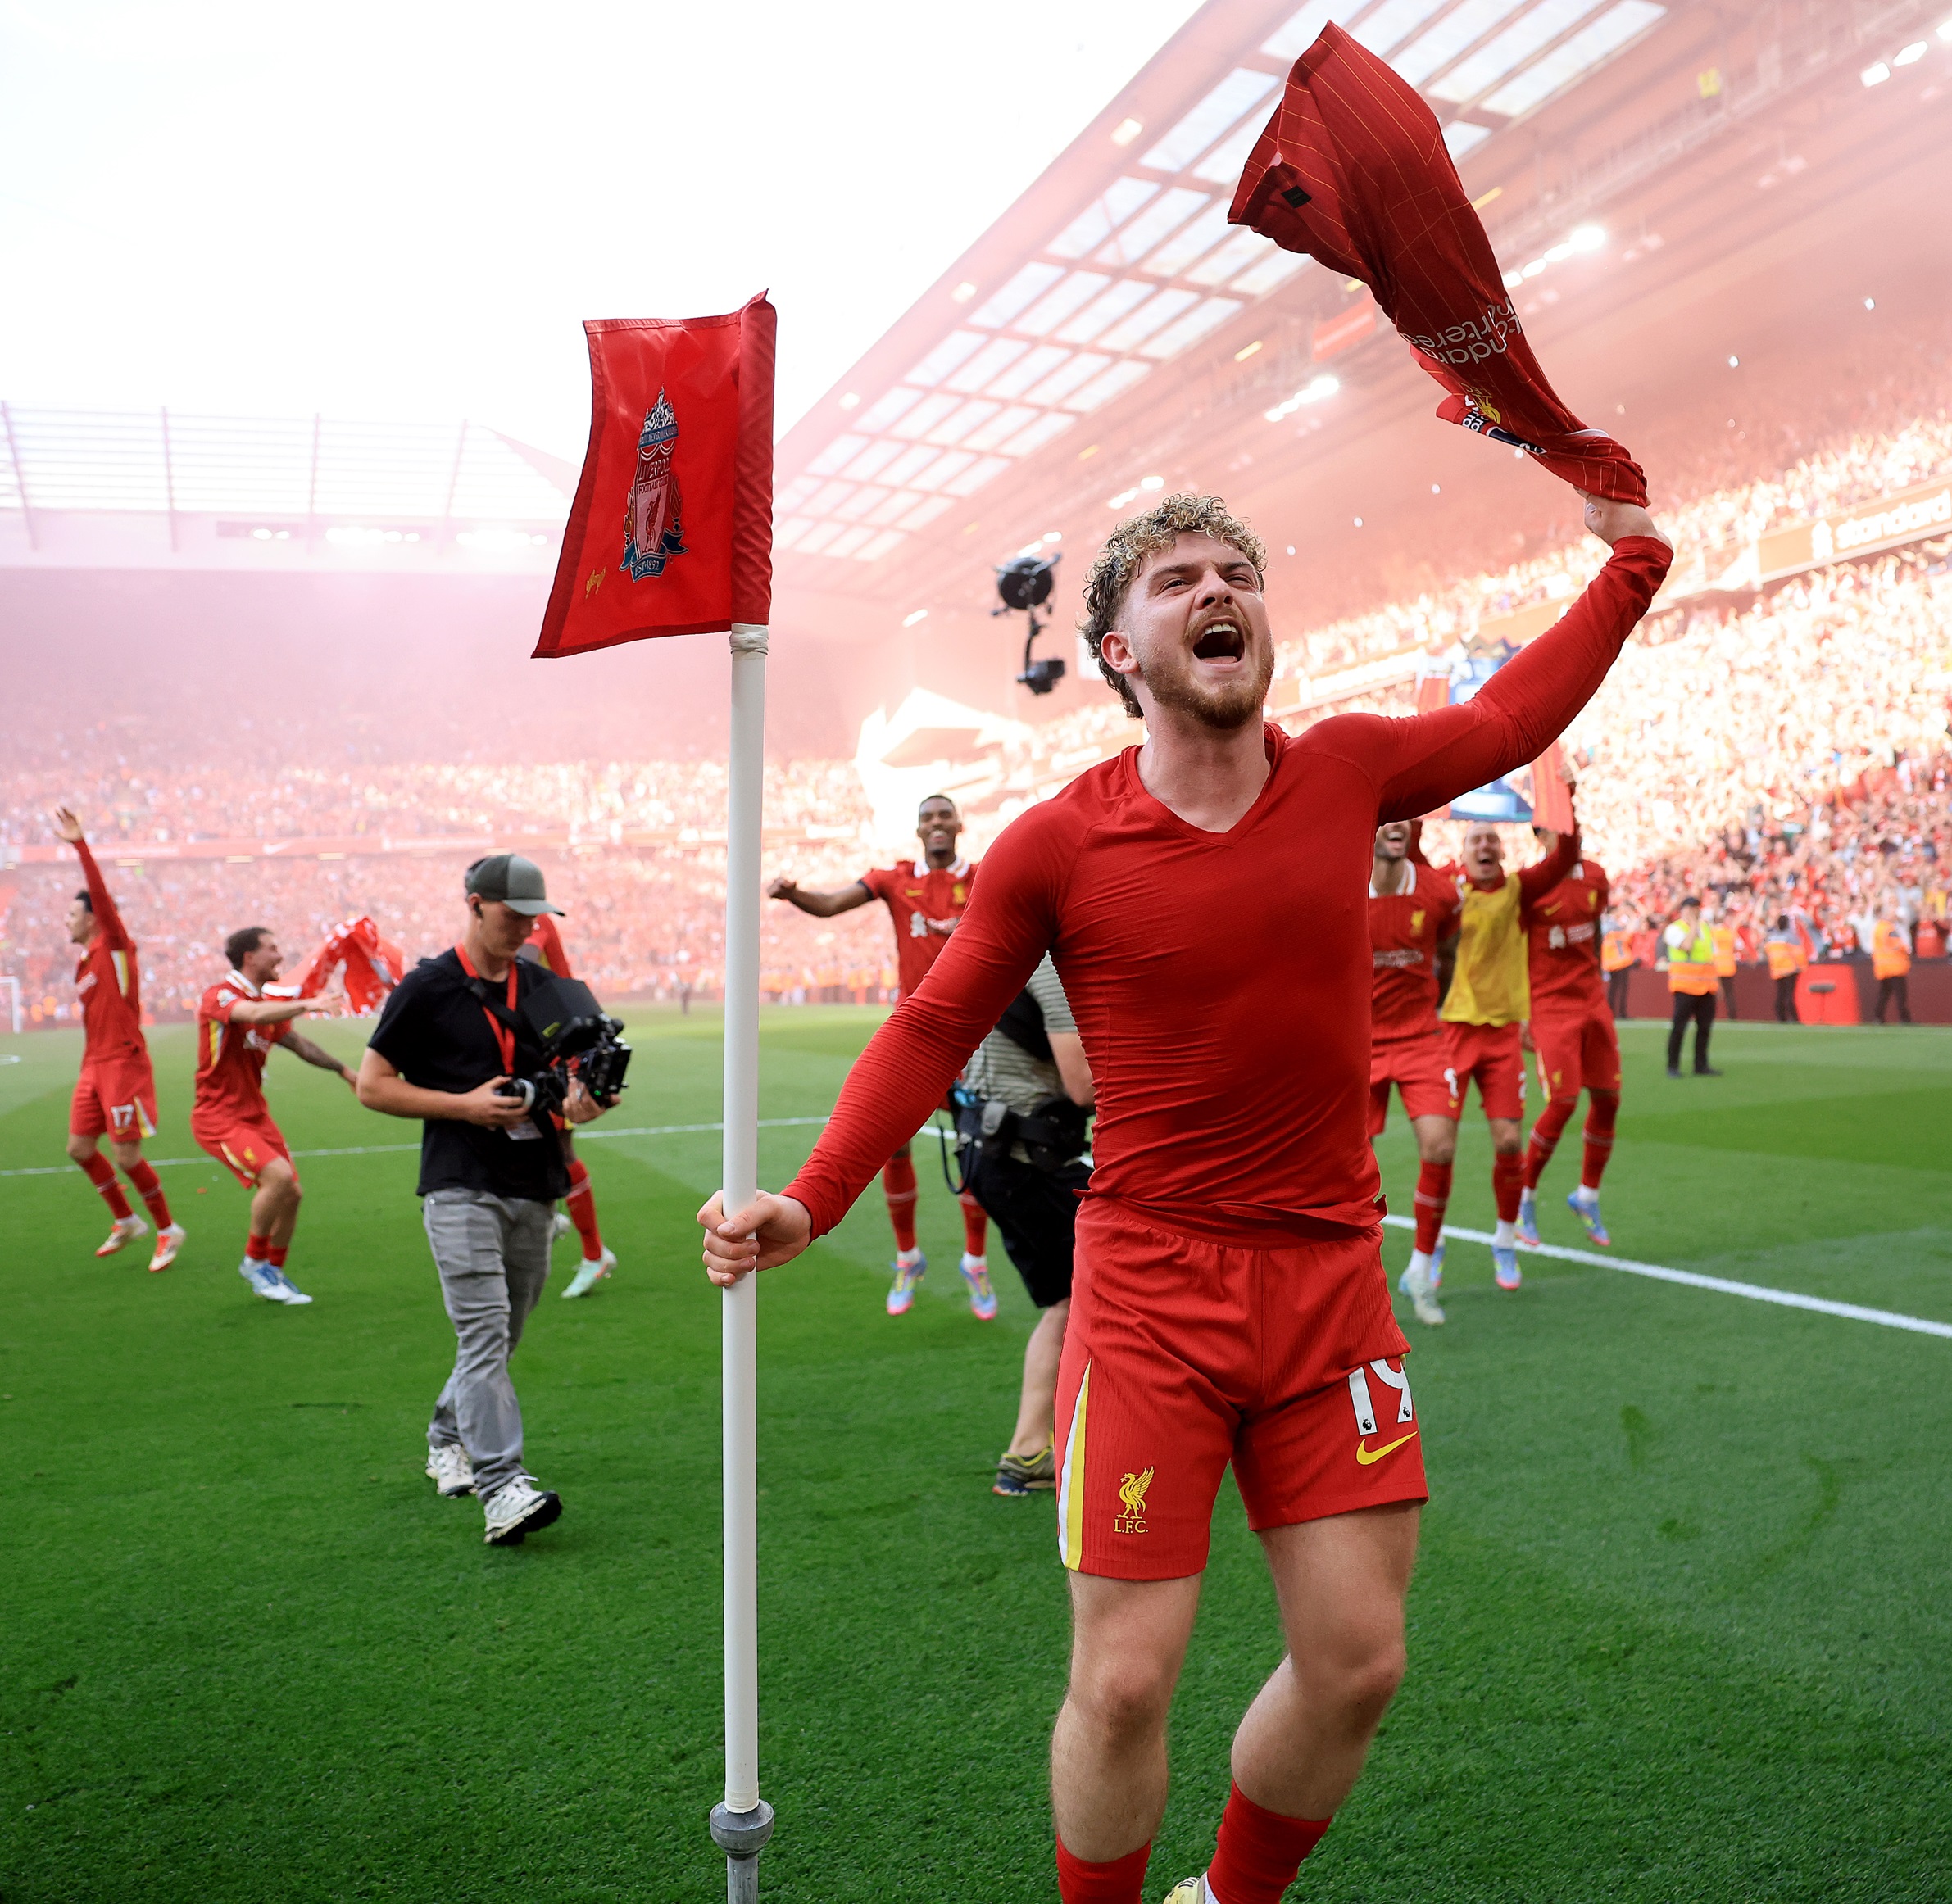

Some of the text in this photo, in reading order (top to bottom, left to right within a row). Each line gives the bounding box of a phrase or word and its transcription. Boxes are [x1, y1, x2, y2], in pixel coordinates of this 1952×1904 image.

[110, 1104, 134, 1127] 17
[1348, 1358, 1413, 1436] 19
[1114, 1518, 1149, 1534] L.F.C.
